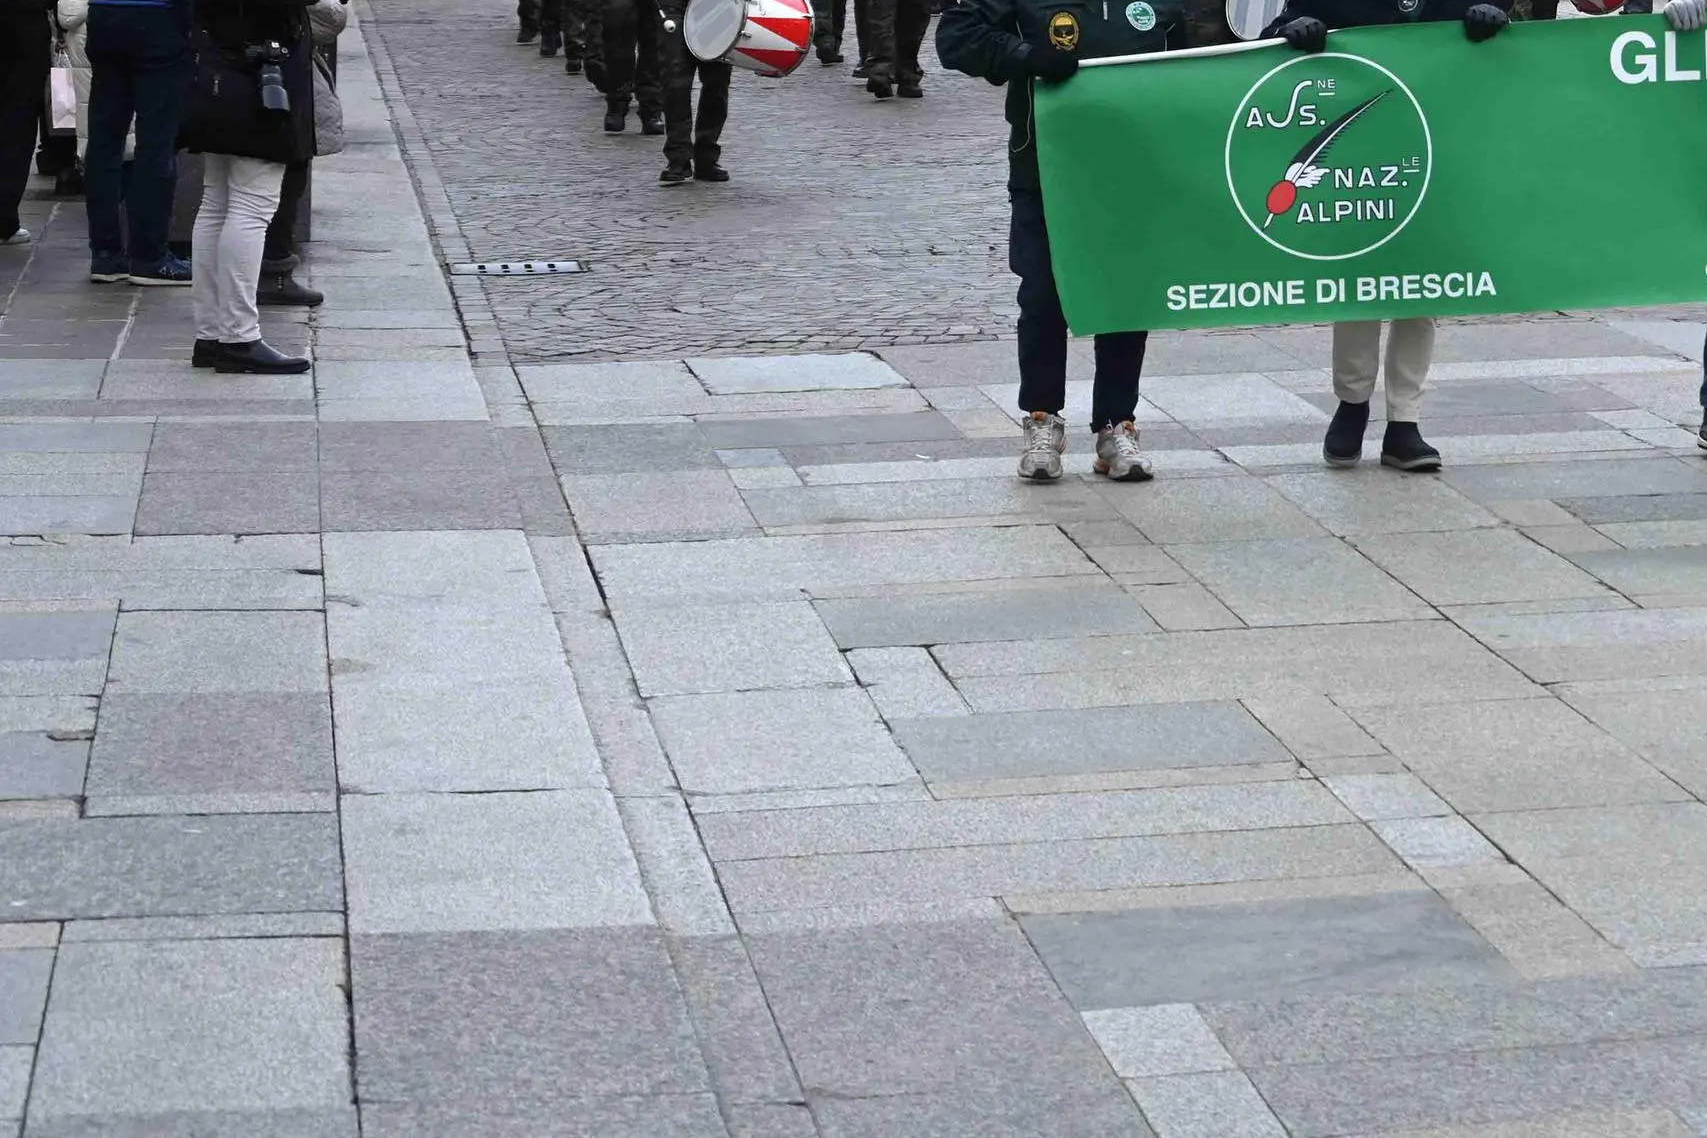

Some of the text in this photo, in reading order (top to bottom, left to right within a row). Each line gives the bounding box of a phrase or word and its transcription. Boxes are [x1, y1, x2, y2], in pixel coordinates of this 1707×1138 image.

[1296, 198, 1395, 224] ALPINI
[1166, 270, 1498, 310] SEZIONE DI BRESCIA
